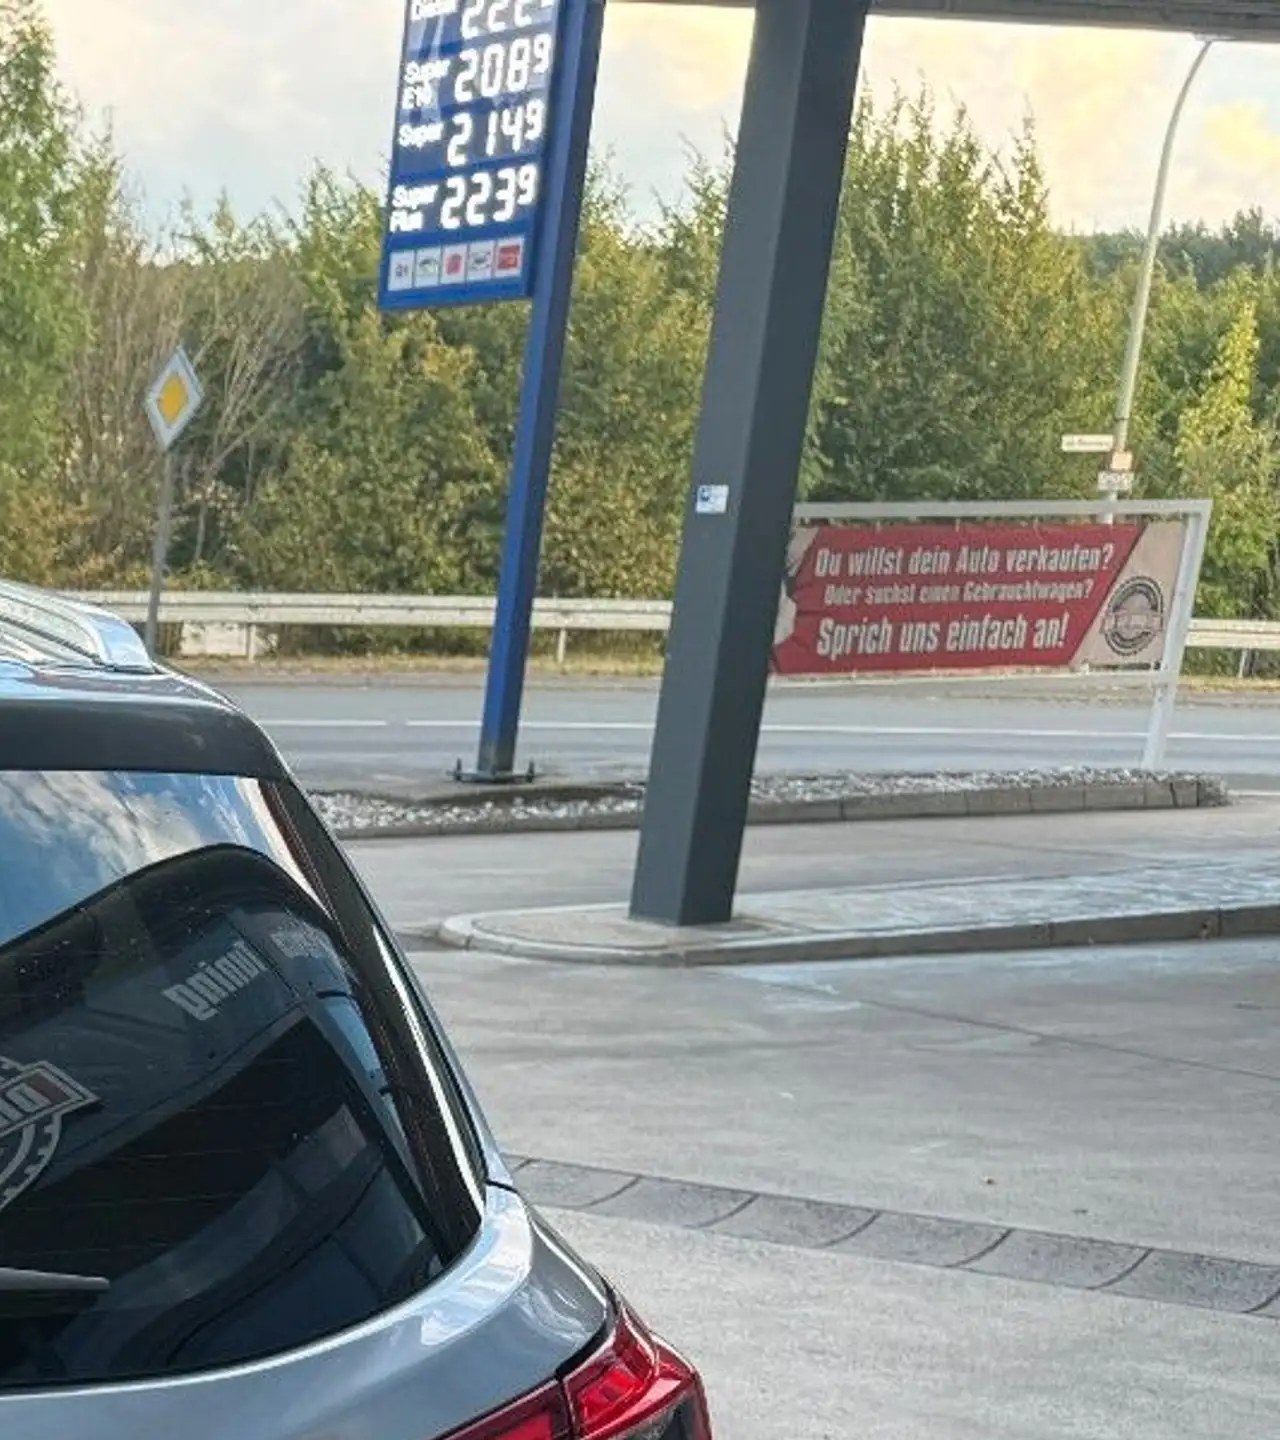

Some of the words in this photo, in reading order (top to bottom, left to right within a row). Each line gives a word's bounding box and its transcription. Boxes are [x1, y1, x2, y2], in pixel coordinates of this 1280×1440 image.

[814, 548, 842, 577] Du
[847, 547, 904, 577] willst
[908, 545, 951, 575] dein
[955, 545, 1000, 573] Auto
[1006, 543, 1114, 573] verkaufen?
[816, 616, 893, 662] Sprich
[898, 620, 941, 653] uns
[945, 613, 1028, 651] einfach
[1032, 610, 1070, 648] an!
